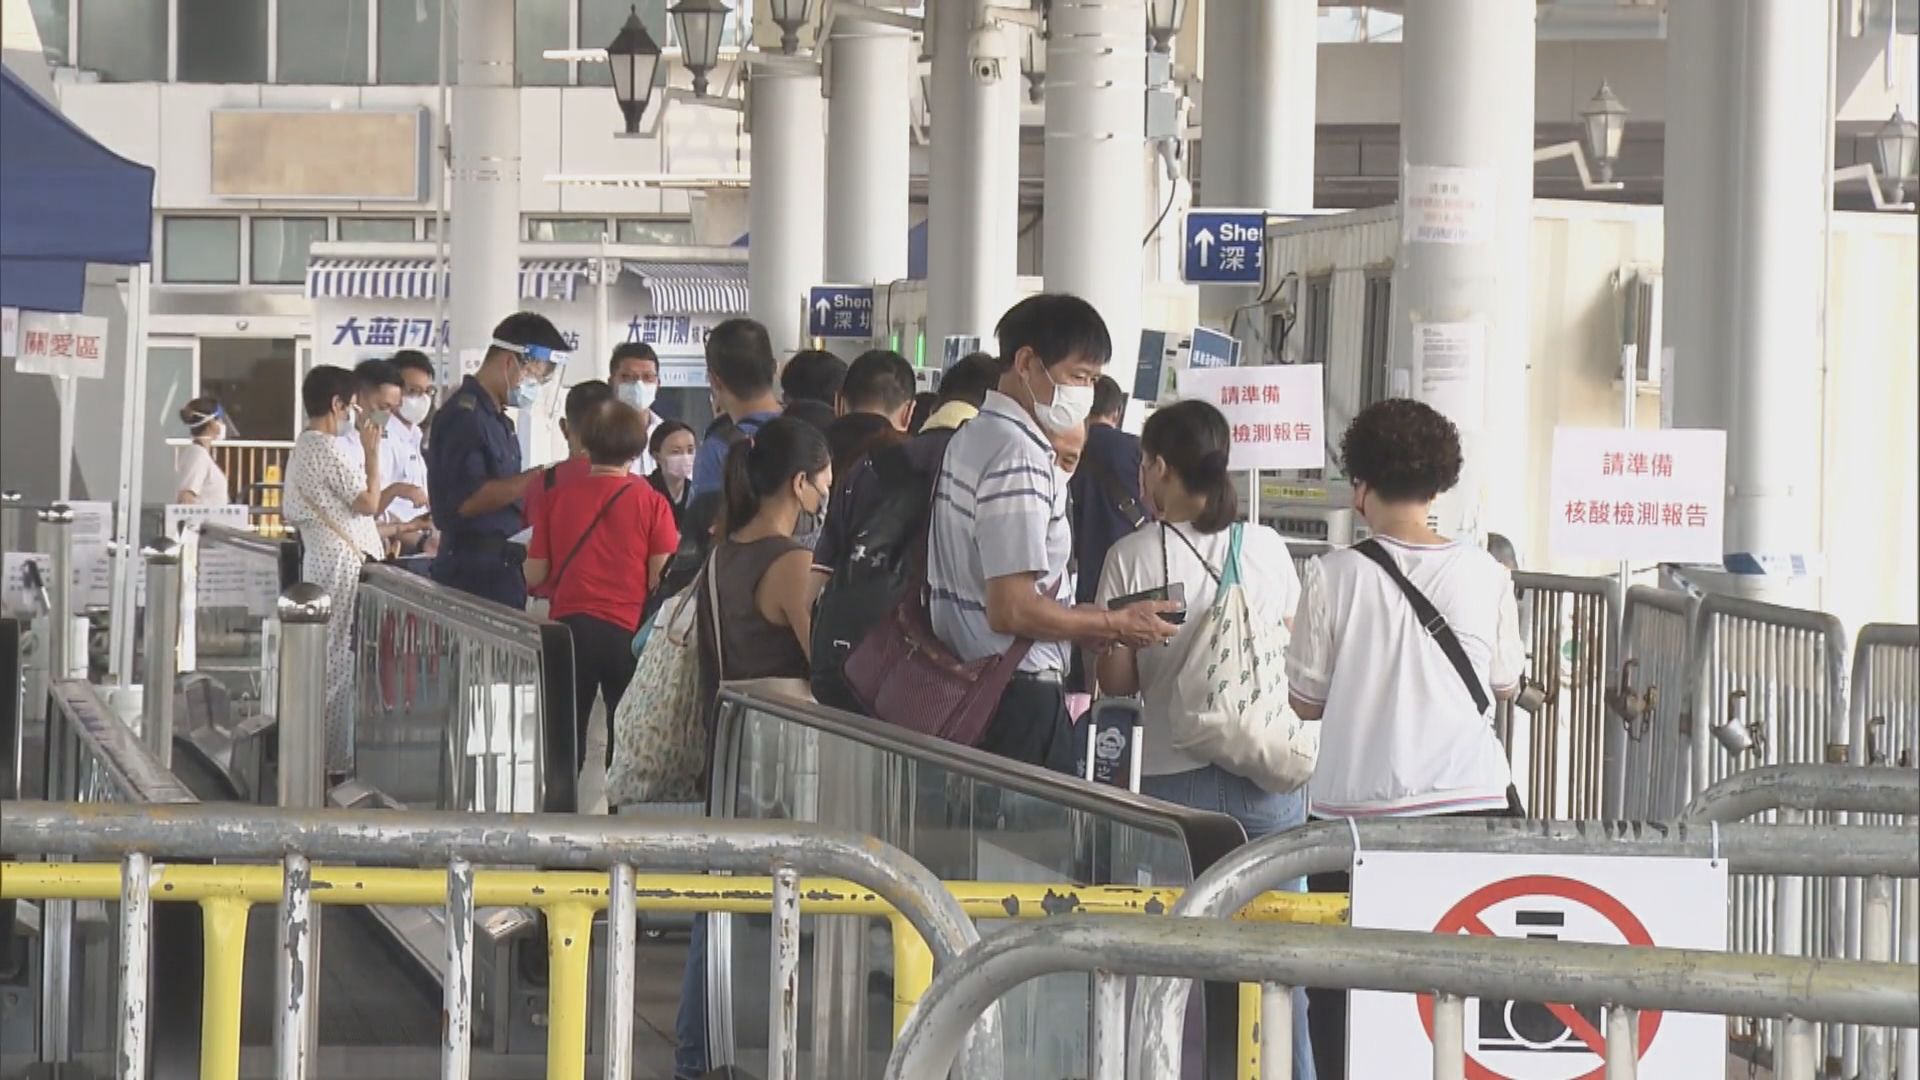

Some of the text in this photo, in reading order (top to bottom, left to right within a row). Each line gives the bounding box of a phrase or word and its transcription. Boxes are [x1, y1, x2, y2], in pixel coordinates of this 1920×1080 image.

[1219, 222, 1263, 241] She
[24, 330, 101, 360] 關愛區
[1221, 385, 1280, 406] 請準備
[1602, 451, 1673, 477] 請準備
[1565, 499, 1708, 528] 核酸檢測報告
